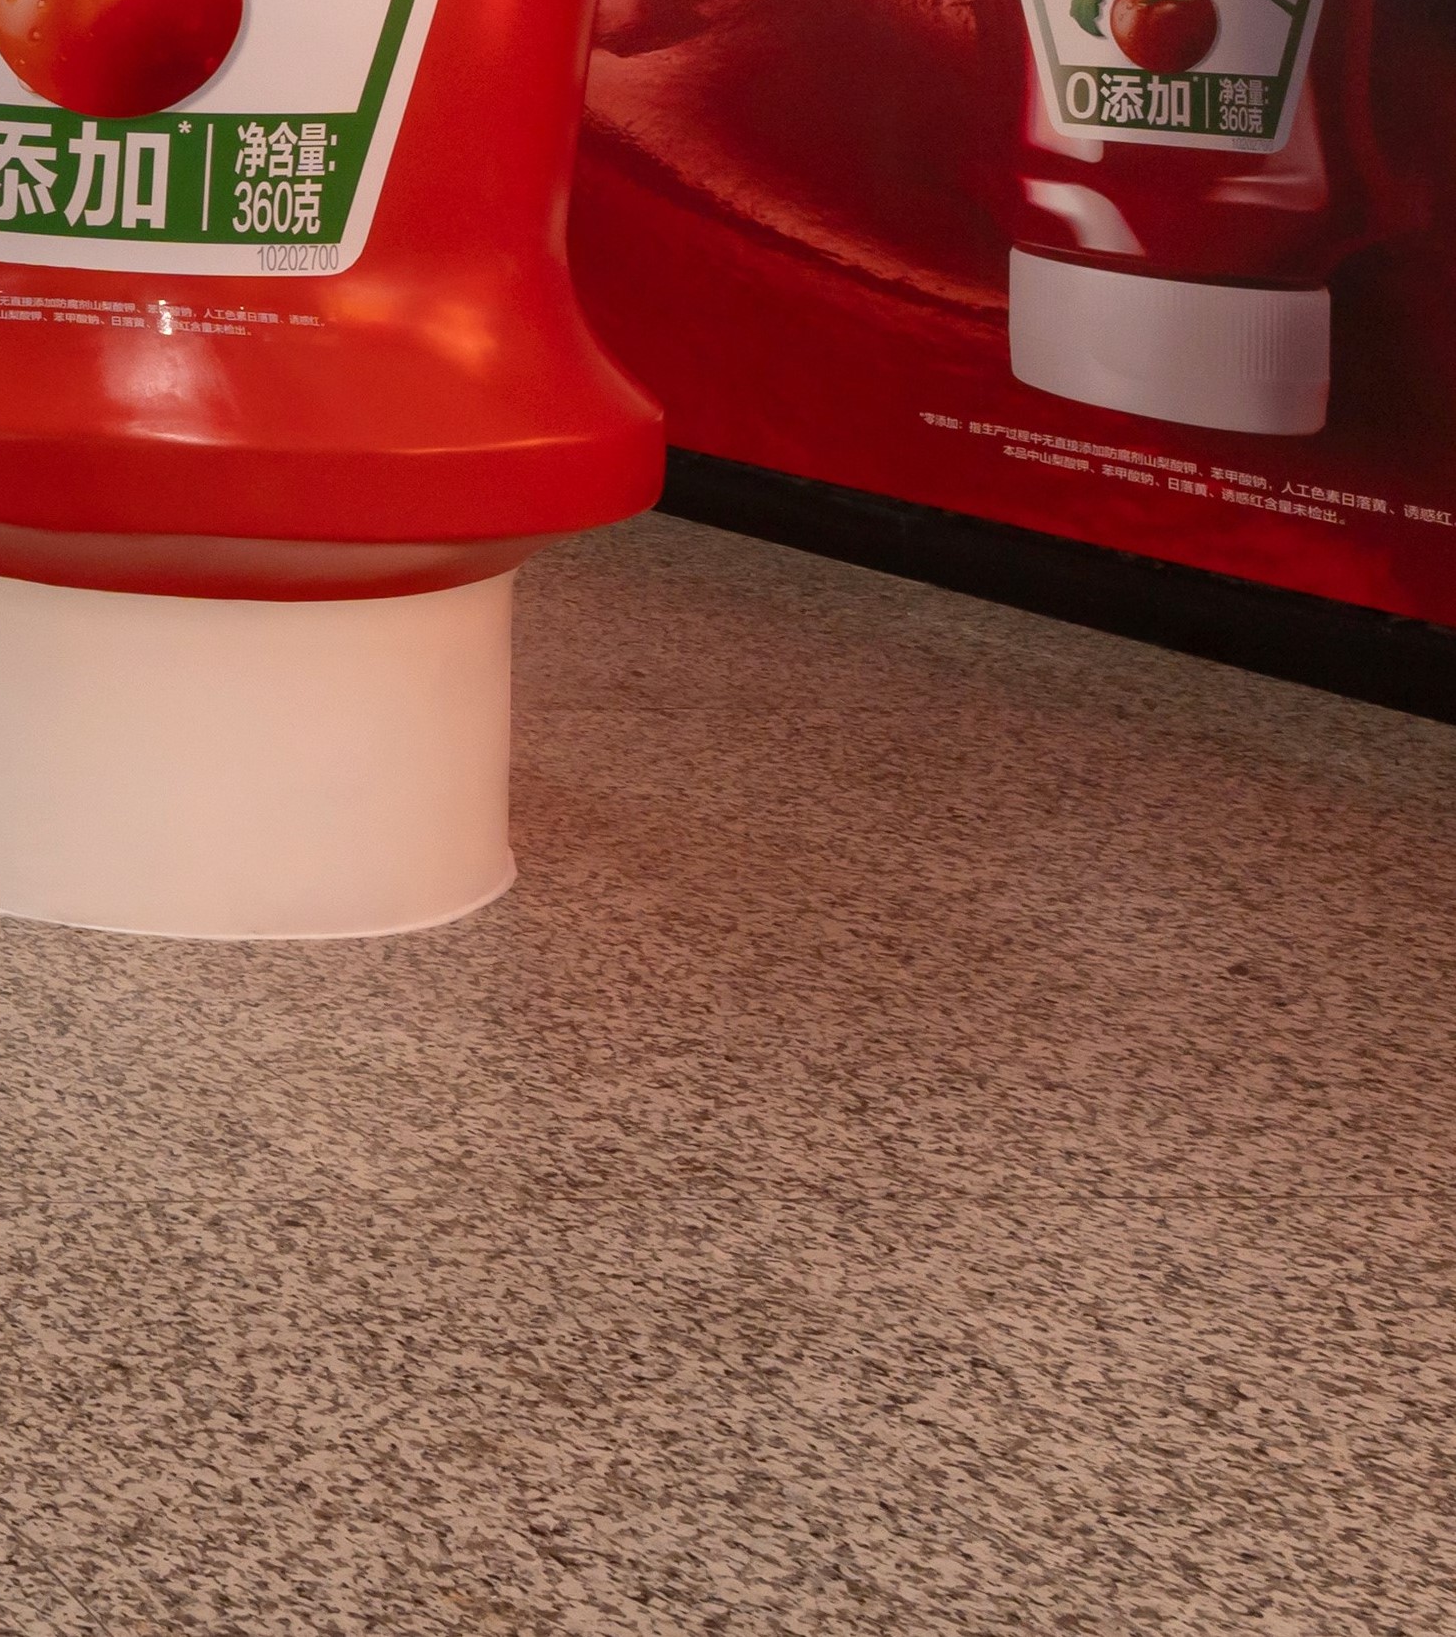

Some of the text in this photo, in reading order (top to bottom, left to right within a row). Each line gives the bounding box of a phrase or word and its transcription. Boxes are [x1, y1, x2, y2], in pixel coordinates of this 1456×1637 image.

[1218, 105, 1264, 135] 360克
[232, 178, 323, 235] 360克
[257, 244, 339, 272] 10202700
